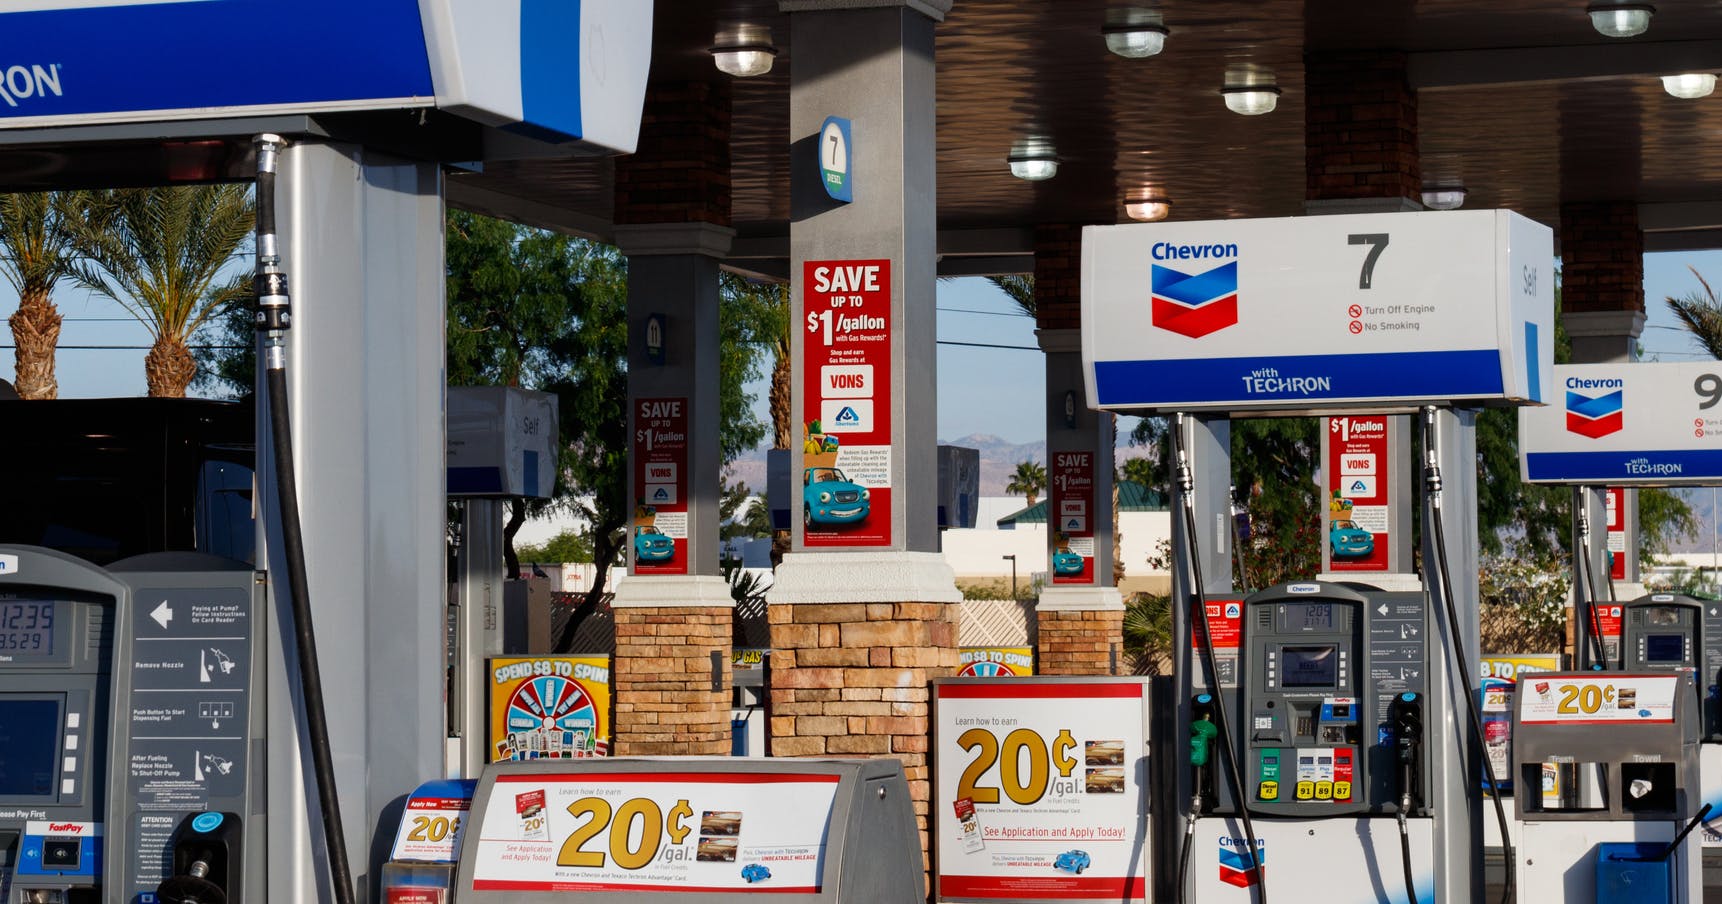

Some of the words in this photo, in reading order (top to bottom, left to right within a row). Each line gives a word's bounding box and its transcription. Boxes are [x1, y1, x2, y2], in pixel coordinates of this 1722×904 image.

[830, 135, 838, 165] 7
[1151, 242, 1238, 260] Chevron
[1347, 233, 1390, 289] 7
[814, 265, 880, 293] SAVE
[1523, 264, 1537, 297] Self
[830, 295, 846, 308] UP
[848, 295, 863, 307] TO
[1364, 306, 1385, 315] Turn
[1387, 305, 1401, 314] Off
[1404, 304, 1435, 315] Engine
[1364, 322, 1378, 331] No
[1380, 320, 1420, 331] Smoking
[1251, 367, 1278, 378] with
[830, 375, 864, 389] VONS
[1242, 376, 1331, 395] TECHRON
[1566, 377, 1623, 389] Chevron
[1693, 373, 1722, 410] 9
[641, 401, 681, 418] SAVE
[523, 416, 539, 437] Self
[651, 420, 660, 428] UP
[1057, 454, 1089, 467] SAVE
[1347, 460, 1370, 469] VONS
[650, 468, 672, 477] VONS
[1624, 462, 1682, 475] TECHRON
[1065, 504, 1081, 512] VONS
[743, 650, 762, 664] GAS
[989, 651, 1003, 662] TO
[495, 661, 533, 683] SPEND
[533, 660, 552, 676] $8
[553, 661, 572, 677] TO
[1493, 661, 1514, 679] TO
[1557, 684, 1615, 714] 20¢
[955, 717, 975, 726] Learn
[975, 717, 990, 726] how
[992, 718, 999, 726] to
[1001, 718, 1018, 726] earn
[1633, 754, 1661, 763] Towel
[956, 728, 1078, 806] 20¢
[1318, 787, 1329, 795] 89
[17, 810, 29, 819] Pay
[30, 810, 46, 818] First
[49, 823, 84, 833] FastPay
[556, 796, 694, 870] 20¢
[984, 826, 999, 837] See
[1001, 826, 1049, 839] Application
[1051, 827, 1067, 837] and
[1070, 827, 1094, 839] Apply
[1097, 826, 1126, 839] Today!
[519, 845, 553, 854] Application
[514, 853, 530, 862] Apply
[532, 853, 551, 862] Today!
